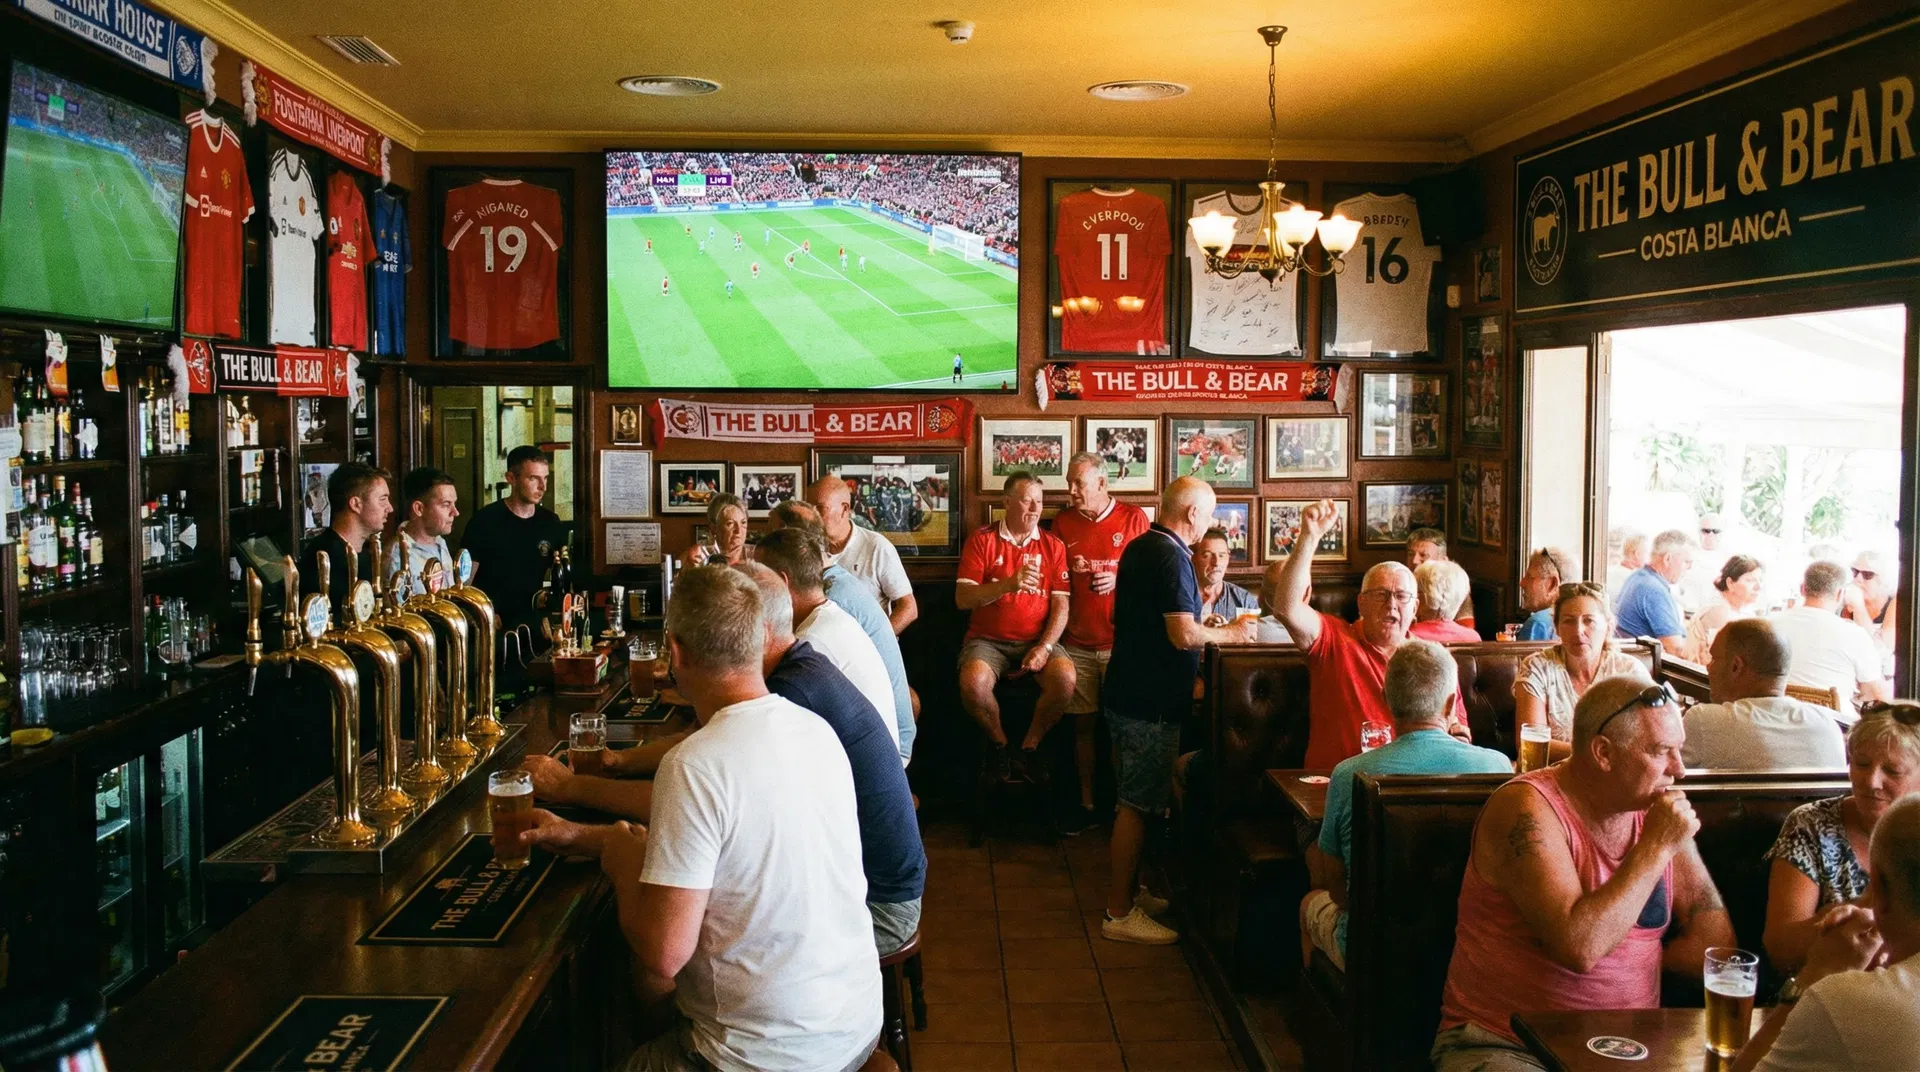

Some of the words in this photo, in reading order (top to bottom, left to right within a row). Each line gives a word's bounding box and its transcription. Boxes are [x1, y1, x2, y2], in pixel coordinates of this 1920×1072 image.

[114, 0, 165, 53] HOUSE
[1574, 161, 1629, 233] THE
[1638, 133, 1726, 219] BULL
[1737, 120, 1768, 195] &
[1781, 76, 1917, 186] BEAR
[480, 226, 528, 273] 19
[1096, 233, 1128, 280] 11
[1640, 228, 1699, 261] COSTA
[1704, 208, 1792, 250] BLANCA
[1361, 236, 1409, 284] 16
[221, 353, 249, 381] THE
[250, 355, 282, 383] BULL
[283, 358, 293, 383] &
[295, 359, 323, 384] BEAR
[1092, 371, 1137, 391] THE
[1143, 370, 1199, 391] BULL
[1205, 371, 1222, 391] &
[1229, 372, 1288, 392] BEAR
[711, 412, 756, 432] THE
[762, 412, 821, 433] BULL
[825, 412, 844, 433] &
[850, 411, 913, 432] BEAR
[430, 907, 470, 931] THE
[453, 879, 494, 906] BULL
[303, 1013, 374, 1065] BEAR
